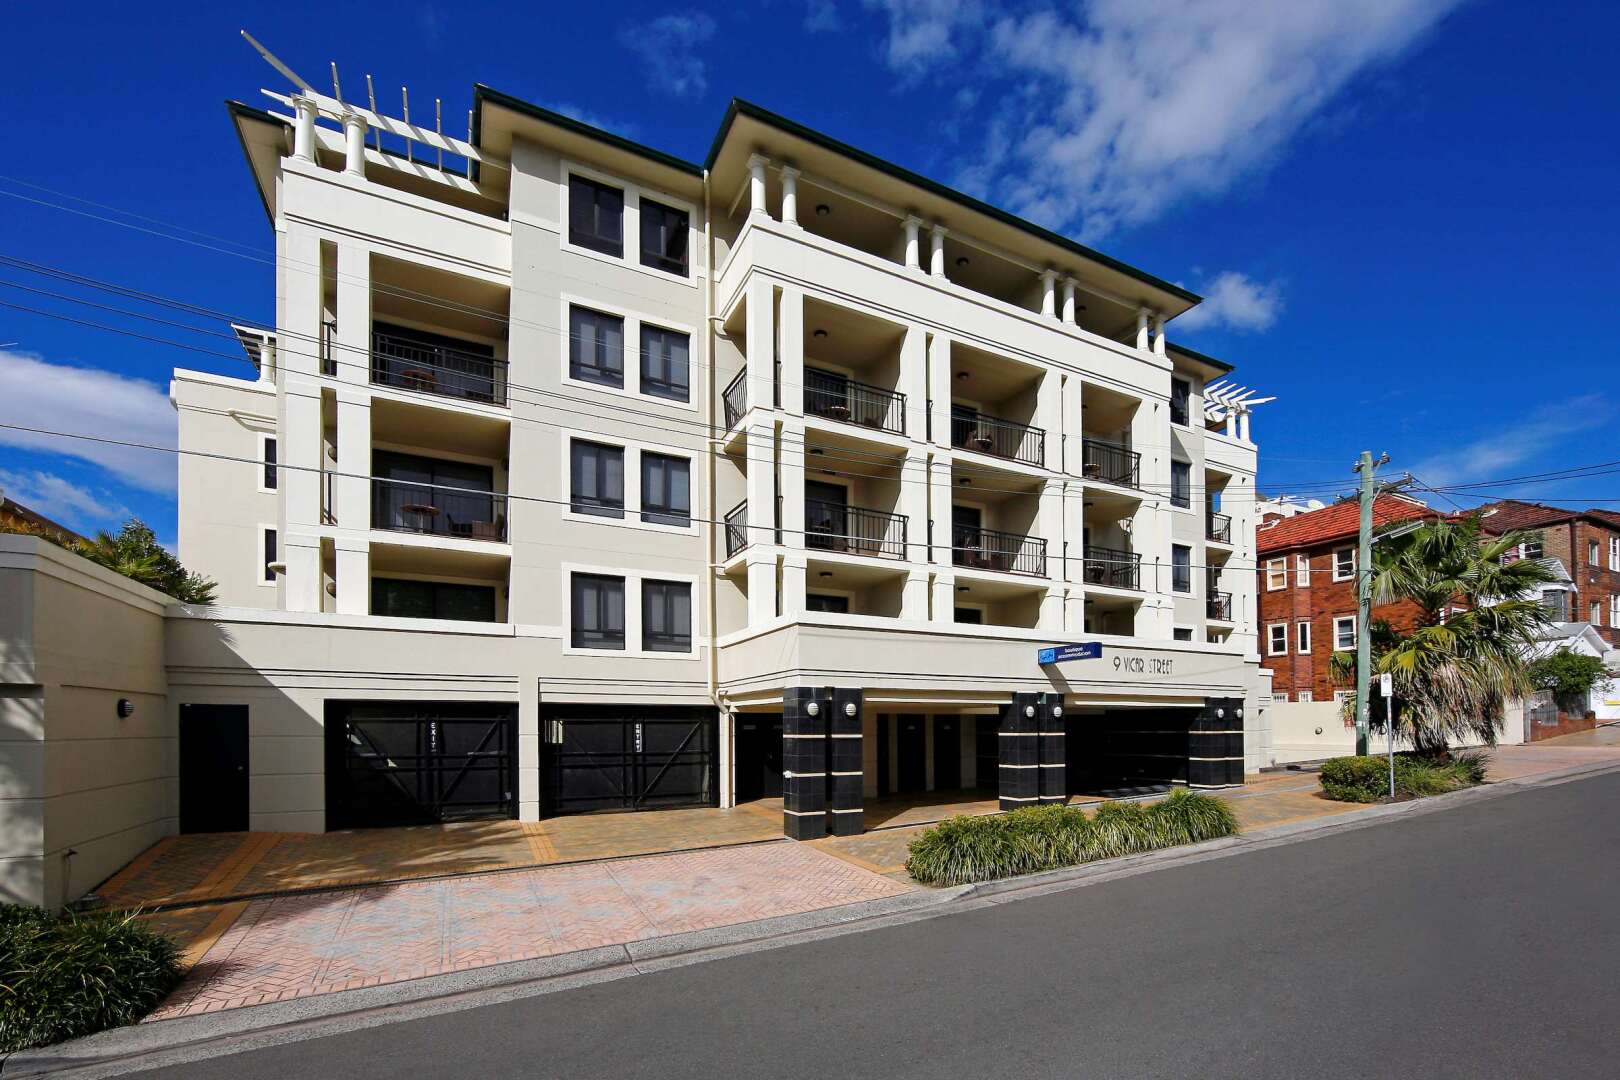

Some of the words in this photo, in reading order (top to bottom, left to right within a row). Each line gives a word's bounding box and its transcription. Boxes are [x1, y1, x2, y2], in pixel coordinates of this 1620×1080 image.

[1113, 656, 1121, 671] 9
[1123, 656, 1145, 673] VICAR
[1149, 658, 1173, 675] STREET
